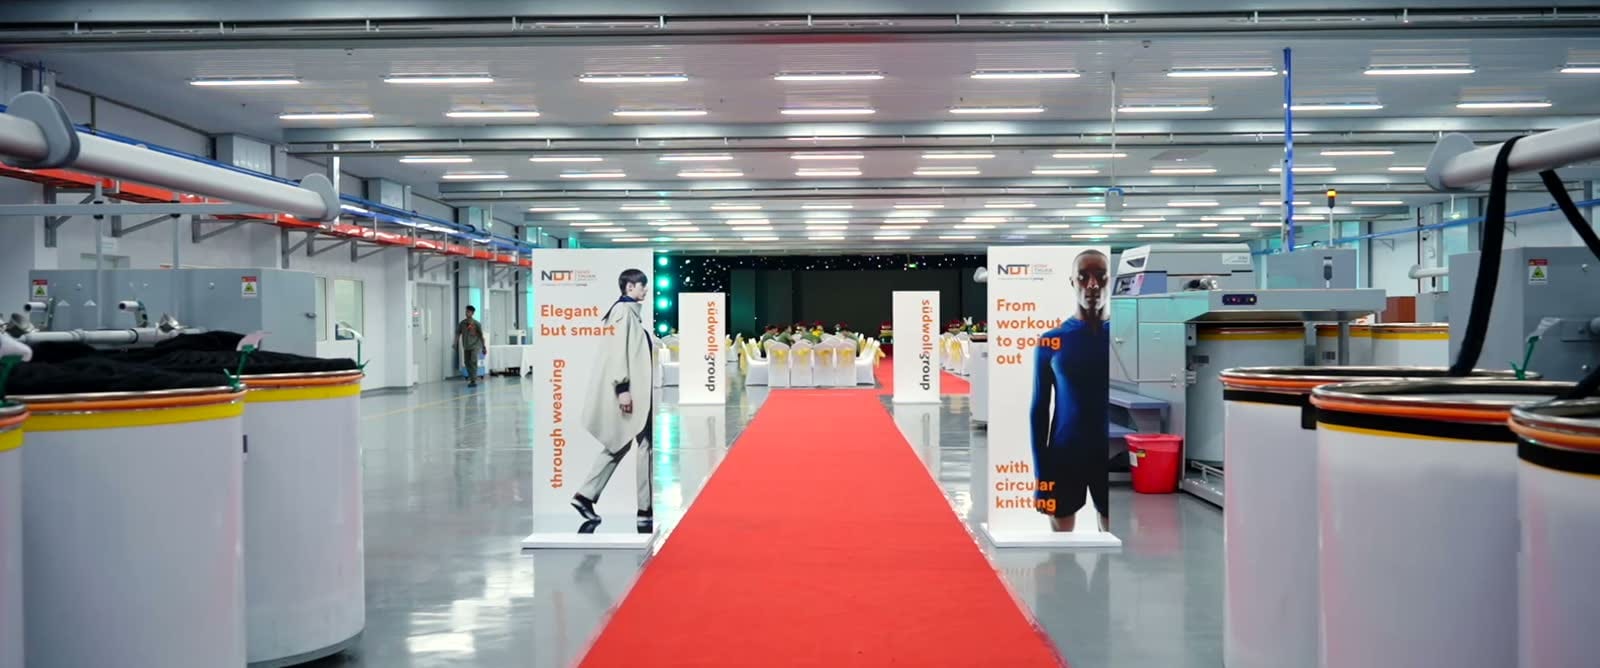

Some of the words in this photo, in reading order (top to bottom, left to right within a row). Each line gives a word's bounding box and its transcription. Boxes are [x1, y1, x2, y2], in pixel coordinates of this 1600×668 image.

[541, 270, 573, 281] NDT
[997, 264, 1030, 275] NDT
[996, 298, 1036, 312] From
[541, 305, 599, 321] Elegant
[996, 316, 1062, 330] workout
[541, 324, 567, 337] but
[571, 324, 616, 337] smart
[996, 336, 1013, 348] to
[1016, 335, 1062, 351] going
[996, 353, 1023, 366] out
[550, 359, 566, 424] weaving
[550, 428, 566, 489] through
[995, 461, 1030, 475] with
[995, 479, 1056, 493] circular
[995, 496, 1057, 513] knitting
